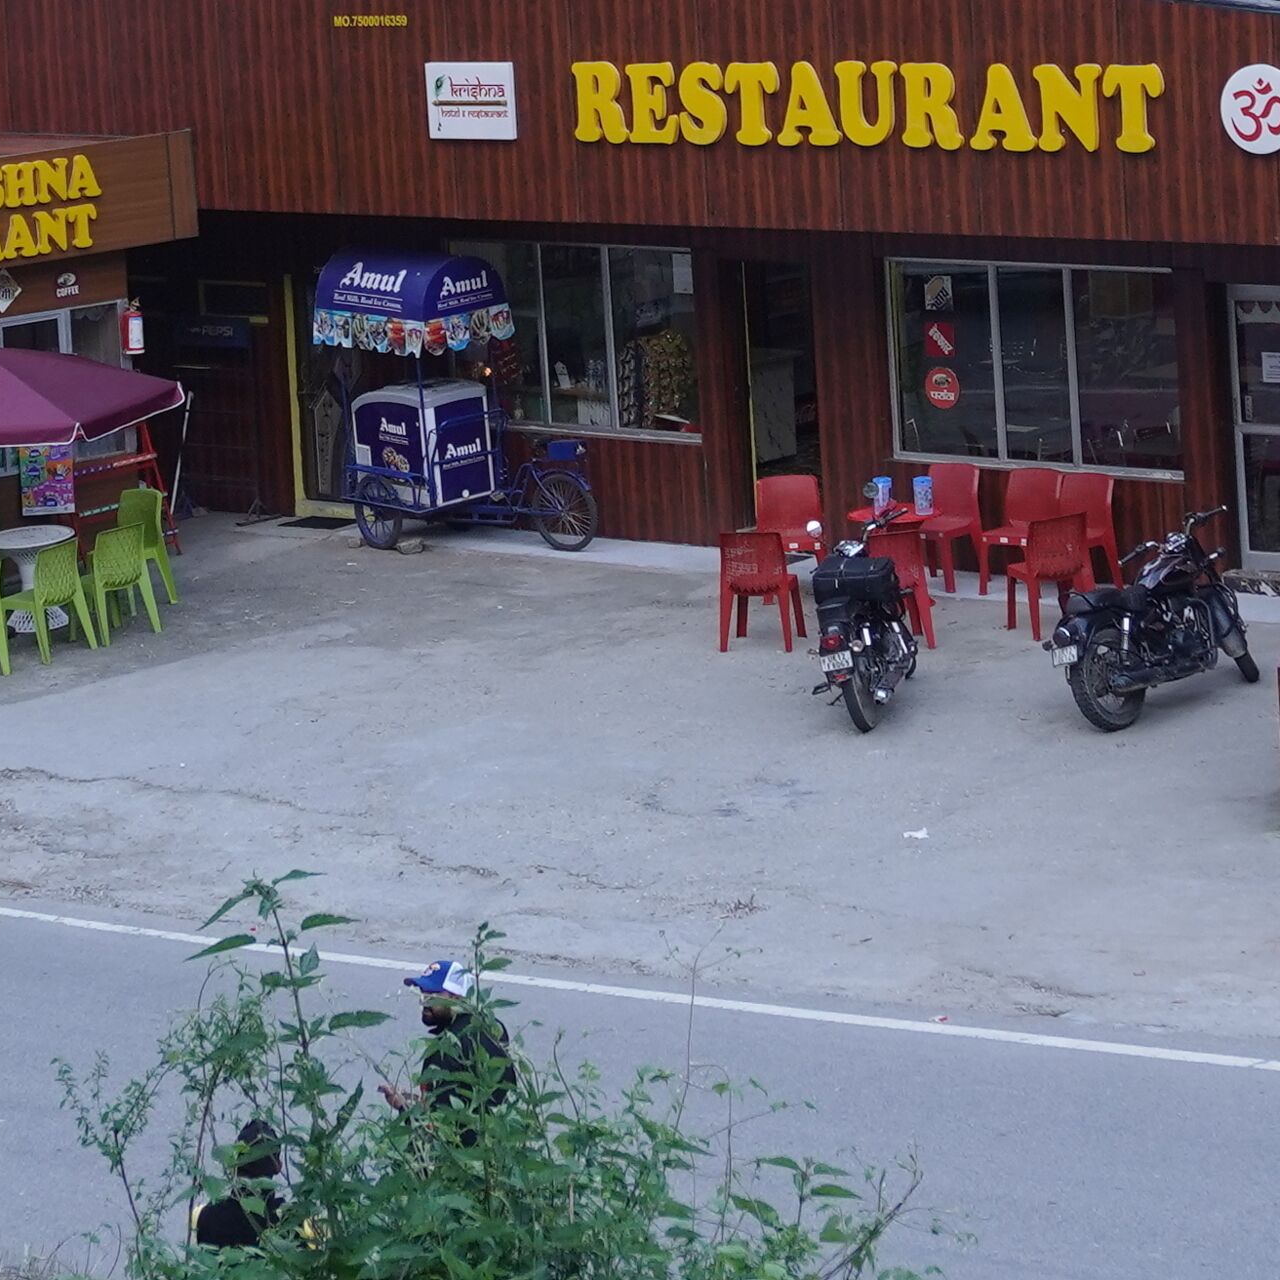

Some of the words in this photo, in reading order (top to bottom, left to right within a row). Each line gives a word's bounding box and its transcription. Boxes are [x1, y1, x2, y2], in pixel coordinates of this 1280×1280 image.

[448, 76, 506, 102] krishna
[570, 57, 1165, 154] RESTAURANT
[340, 261, 408, 294] Amul
[439, 270, 489, 300] Amul
[56, 285, 80, 298] COFFEE
[380, 417, 406, 436] Amul
[444, 437, 482, 461] Amul
